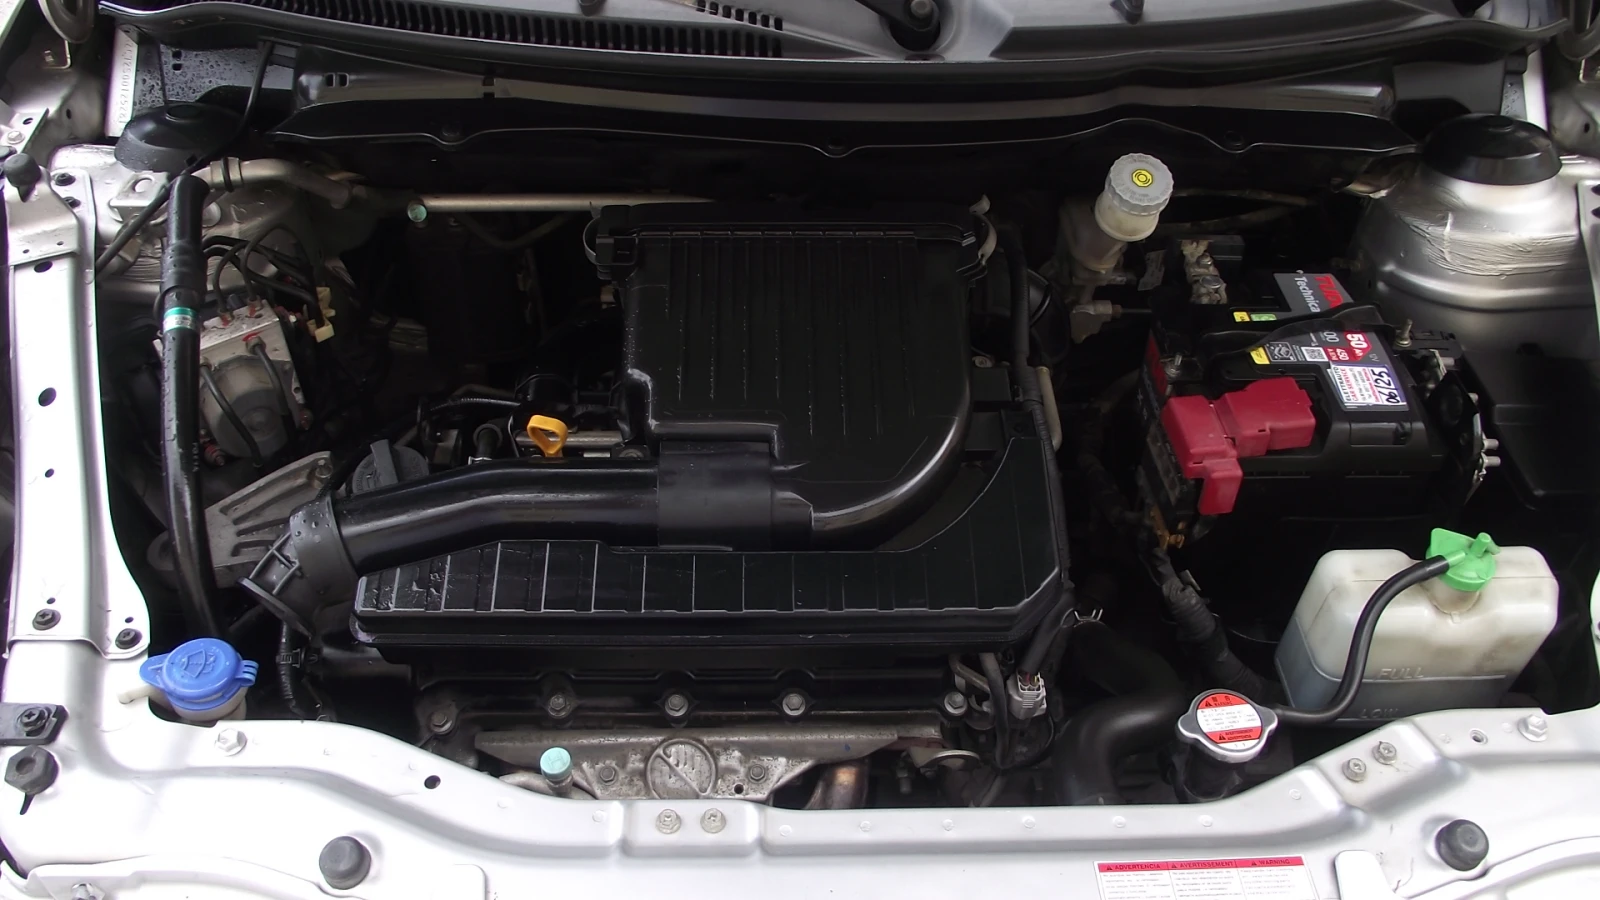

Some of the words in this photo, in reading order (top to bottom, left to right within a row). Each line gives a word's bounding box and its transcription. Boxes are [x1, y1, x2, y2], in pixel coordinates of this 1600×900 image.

[1294, 276, 1321, 312] Technica
[1314, 274, 1343, 309] TUD
[1345, 333, 1368, 348] 50
[1332, 366, 1352, 401] ELETTRAUTO
[1339, 367, 1353, 389] SERVICE
[1371, 367, 1401, 404] 06/25
[1348, 390, 1358, 401] CAR
[1379, 668, 1424, 679] FULL
[1361, 708, 1398, 719] LOW
[1180, 861, 1234, 869] AVERTISSEMENT
